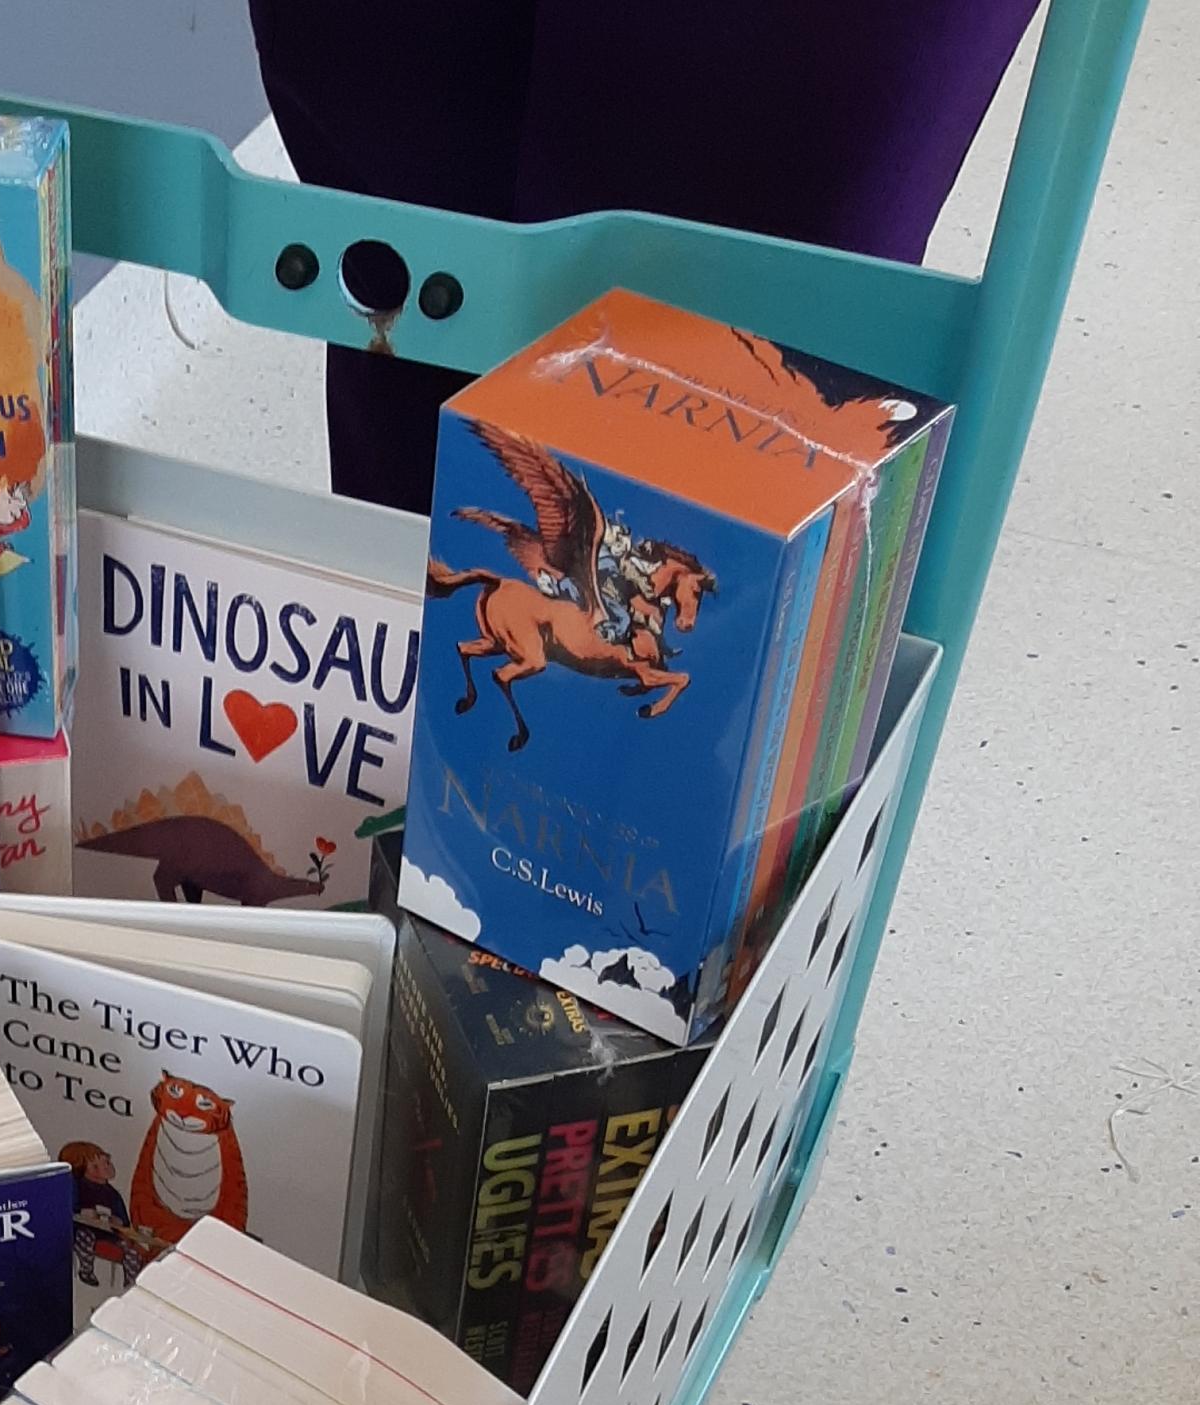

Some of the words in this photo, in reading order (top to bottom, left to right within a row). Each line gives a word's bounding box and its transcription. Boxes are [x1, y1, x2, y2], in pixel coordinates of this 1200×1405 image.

[579, 354, 821, 470] NARNIA
[119, 667, 171, 728] IN
[438, 765, 680, 916] NARNIA
[491, 846, 604, 917] C.S.Lewis
[0, 973, 80, 1021] The
[93, 998, 209, 1056] Tiger
[220, 1034, 326, 1088] Who
[3, 1019, 122, 1074] Came
[5, 1060, 43, 1092] to
[56, 1072, 134, 1117] Tea
[466, 1132, 543, 1292] UGLIES
[525, 1119, 599, 1293] PRETTIES
